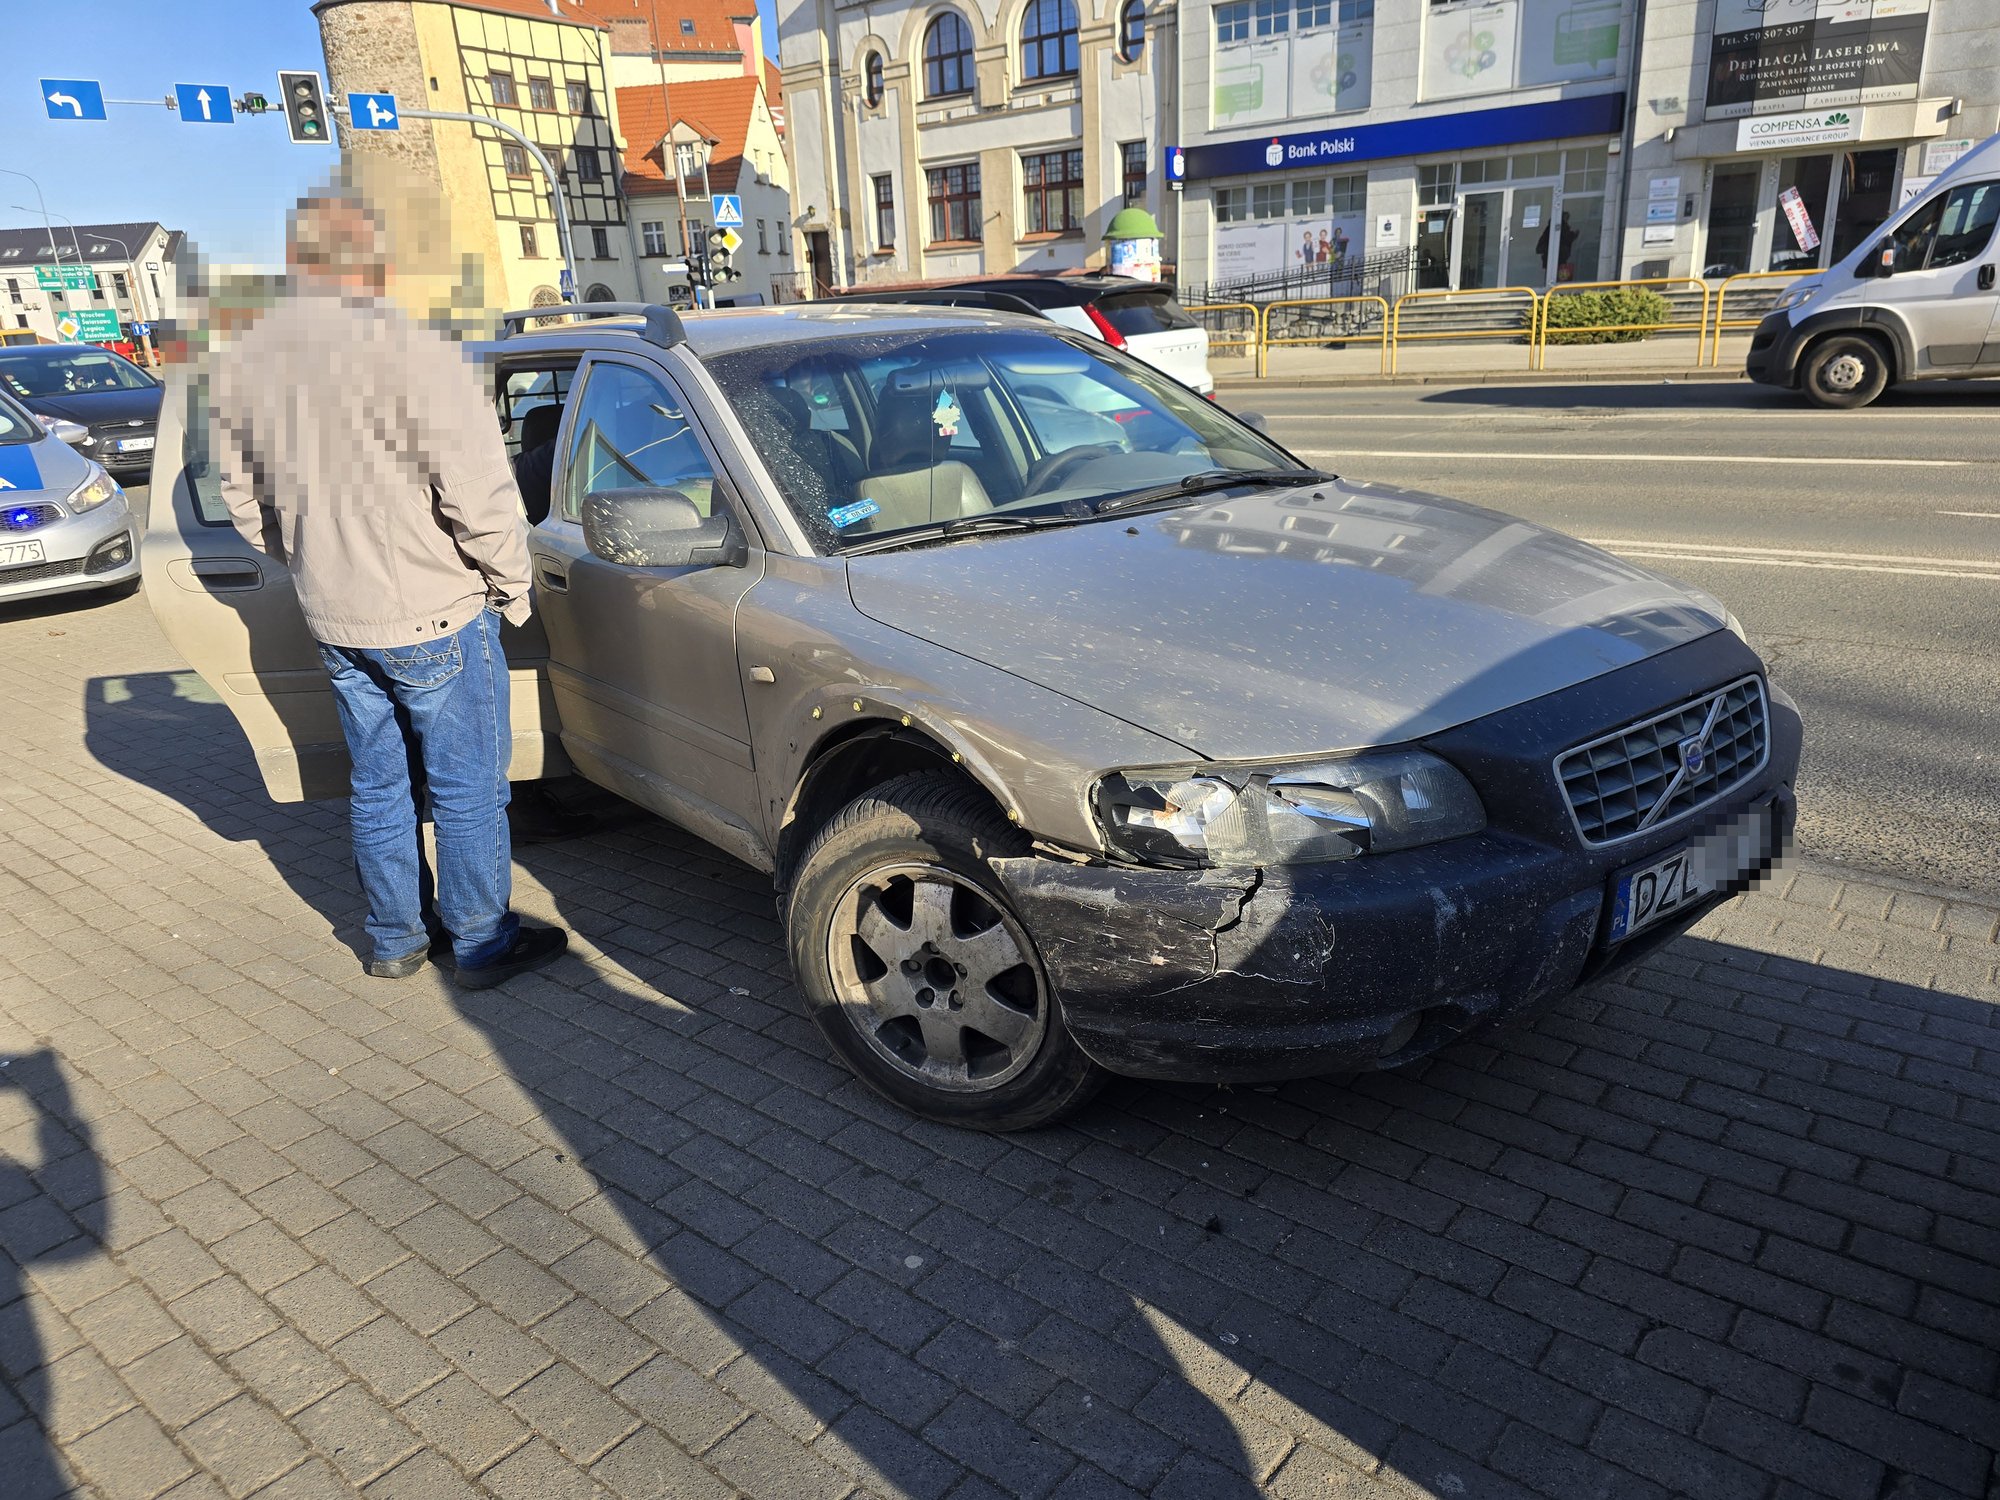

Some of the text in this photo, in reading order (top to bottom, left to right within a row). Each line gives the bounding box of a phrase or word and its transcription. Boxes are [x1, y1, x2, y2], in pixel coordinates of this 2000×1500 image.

[1743, 32, 1761, 43] 570
[1763, 28, 1783, 40] 507
[1785, 25, 1805, 37] 507
[1814, 41, 1900, 60] LASEROWA
[1739, 70, 1785, 82] REDUKCJA
[1787, 65, 1816, 76] BLIZN
[1759, 71, 1857, 88] ZAMYKANIE NACZYNEK
[1663, 97, 1680, 110] 56
[1750, 118, 1822, 135] COMPENSA
[1288, 142, 1318, 159] Bank
[1320, 137, 1355, 155] Polski
[1749, 132, 1849, 148] VIENNA INSURANCE GROUP
[1634, 856, 1698, 926] DZL
[1612, 914, 1626, 931] PL
